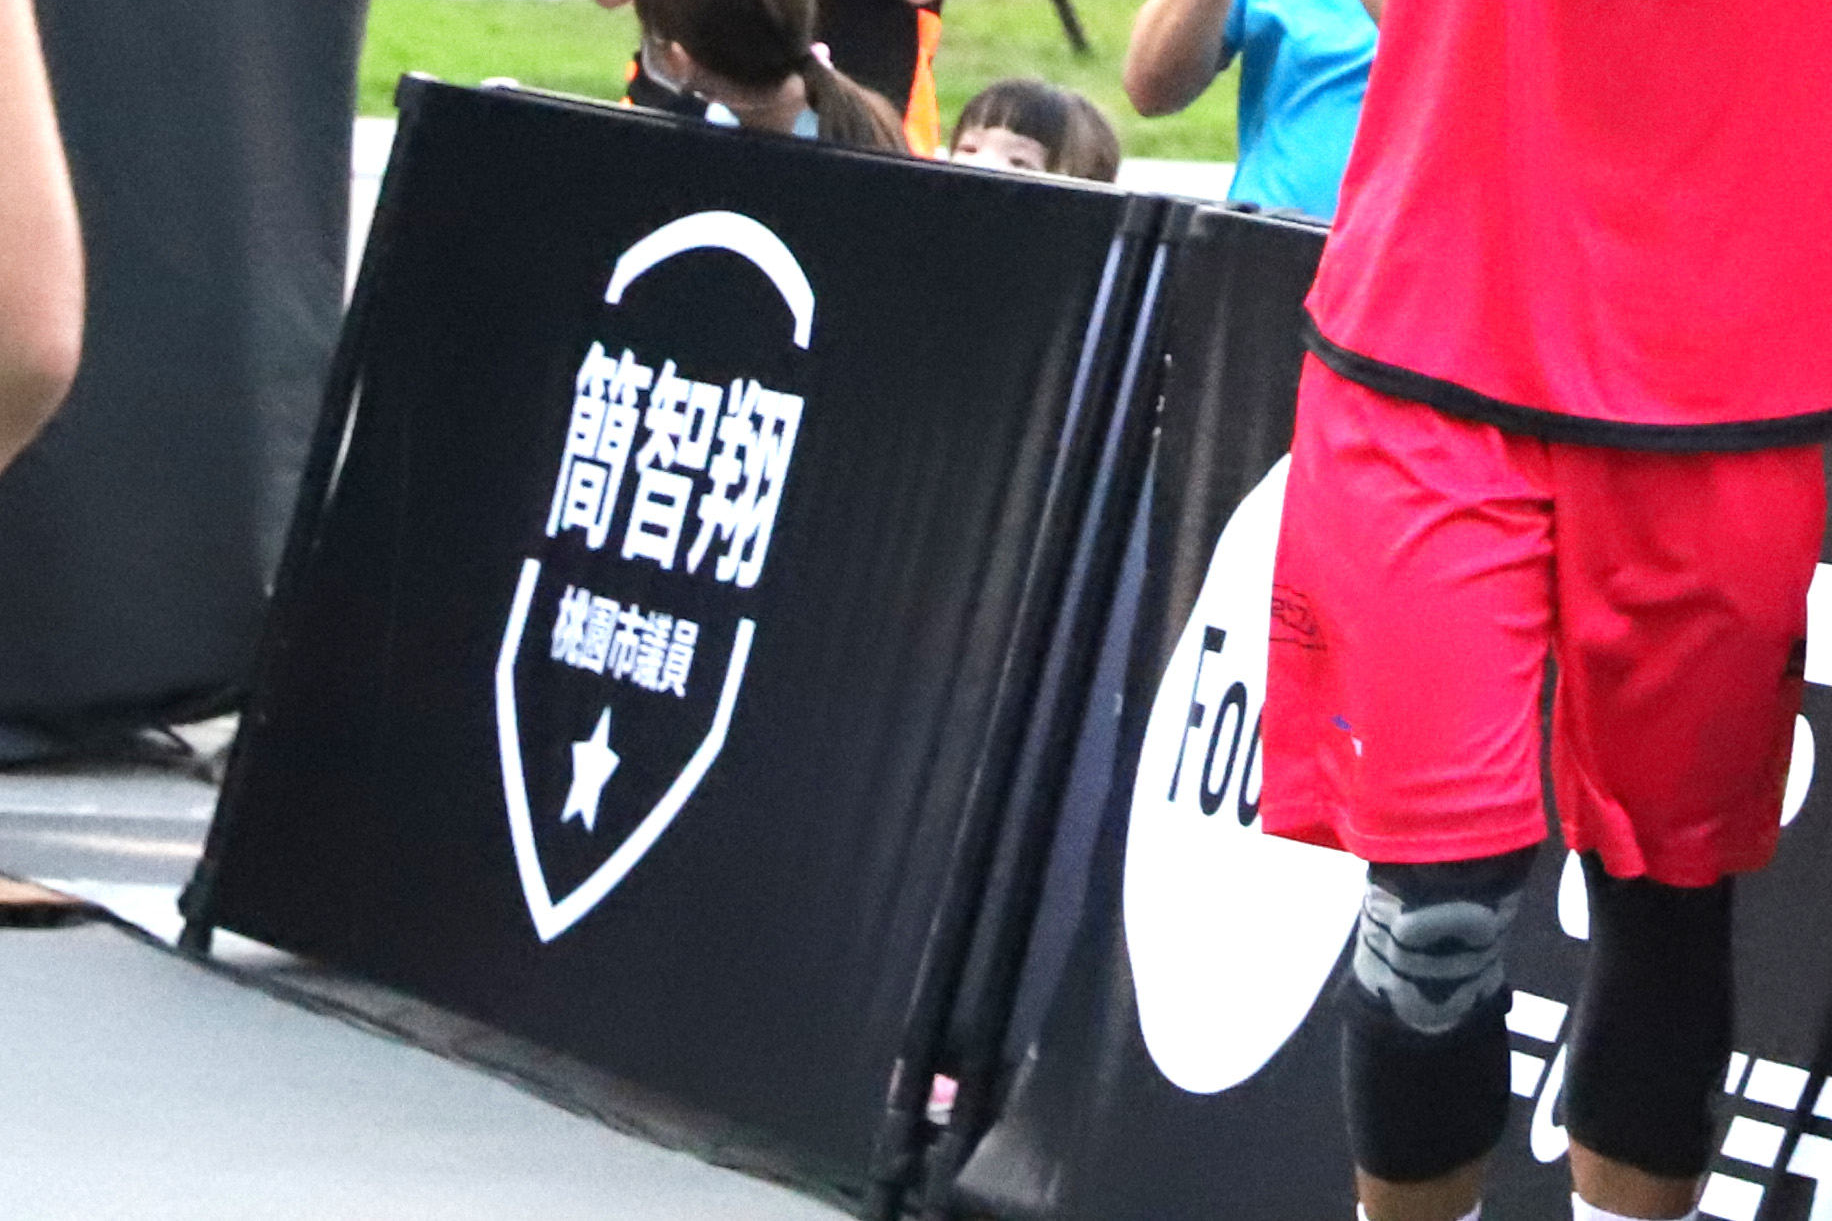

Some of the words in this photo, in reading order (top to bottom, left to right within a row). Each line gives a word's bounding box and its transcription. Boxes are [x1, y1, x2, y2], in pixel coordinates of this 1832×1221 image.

[546, 340, 805, 588] 簡智翔
[551, 584, 700, 698] 桃園市議員
